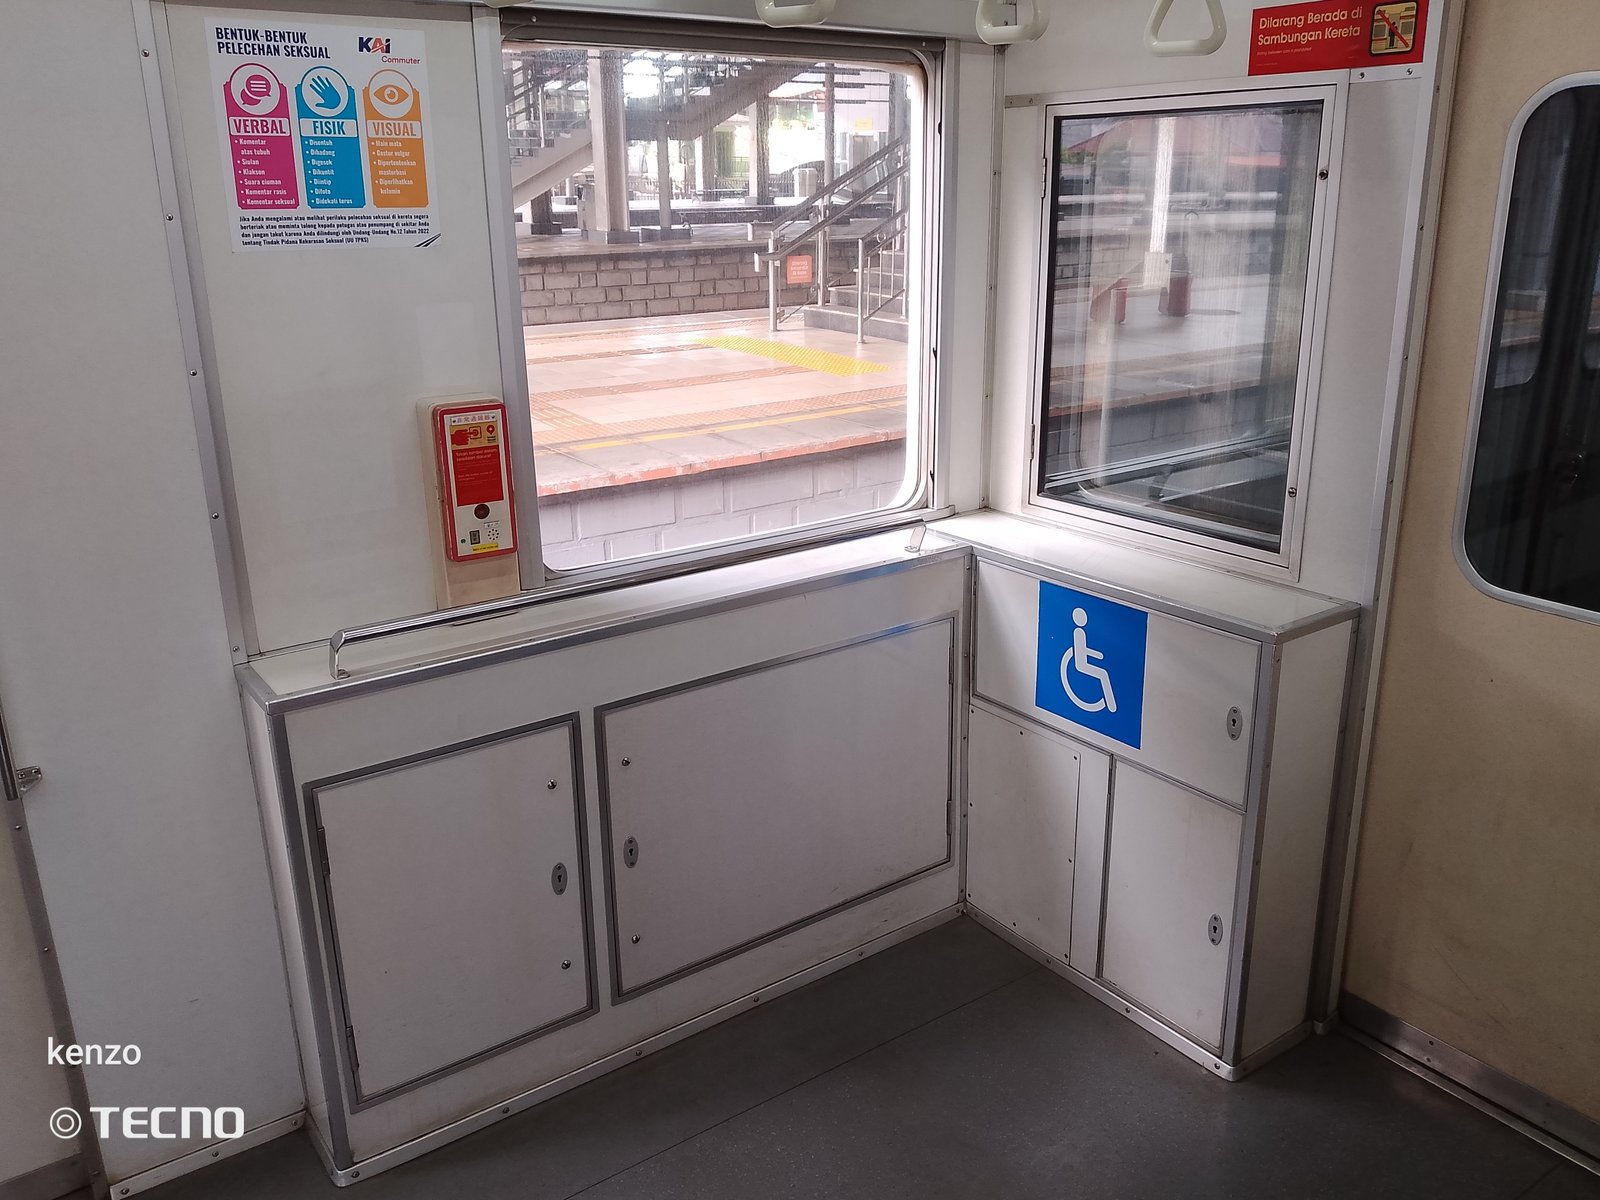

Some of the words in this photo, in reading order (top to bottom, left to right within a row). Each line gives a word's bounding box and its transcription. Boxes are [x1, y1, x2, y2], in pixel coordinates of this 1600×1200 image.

[1260, 16, 1304, 29] Dilarang
[1308, 9, 1347, 24] Berada
[1351, 7, 1362, 18] di
[216, 27, 308, 44] BENTUK-BENTUK
[1258, 30, 1322, 45] Sambungan
[1324, 26, 1360, 39] Kereta
[218, 42, 280, 56] PELECEHAN
[284, 45, 330, 59] SEKSUAL
[382, 56, 420, 64] Commuter
[233, 119, 286, 134] VERBAL
[313, 121, 345, 135] FISIK
[372, 122, 416, 136] VISUAL
